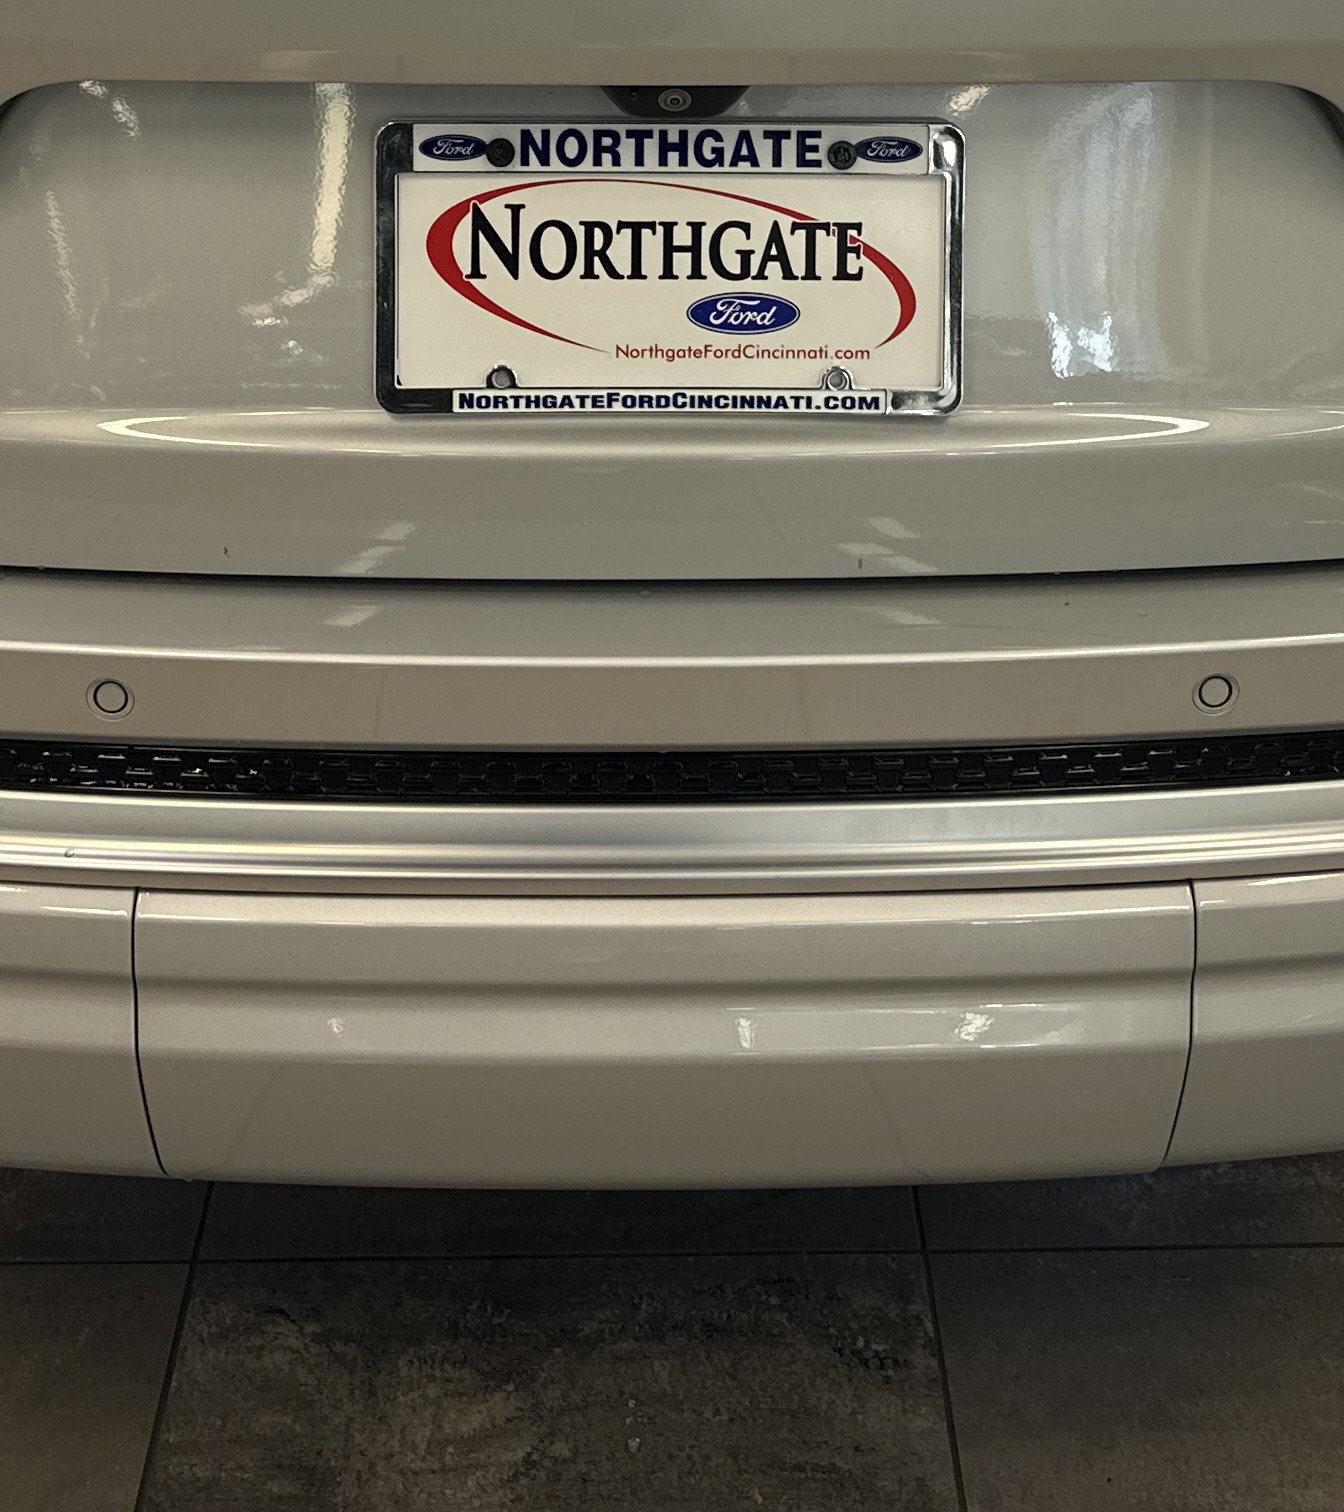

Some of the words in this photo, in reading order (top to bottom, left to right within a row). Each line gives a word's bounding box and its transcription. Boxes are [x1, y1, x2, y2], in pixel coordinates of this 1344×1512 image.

[519, 128, 824, 169] NORTHGATE
[464, 202, 865, 282] NORTHGATE
[709, 297, 776, 329] Ford
[614, 343, 871, 364] NorthgateFordCincinnati.com
